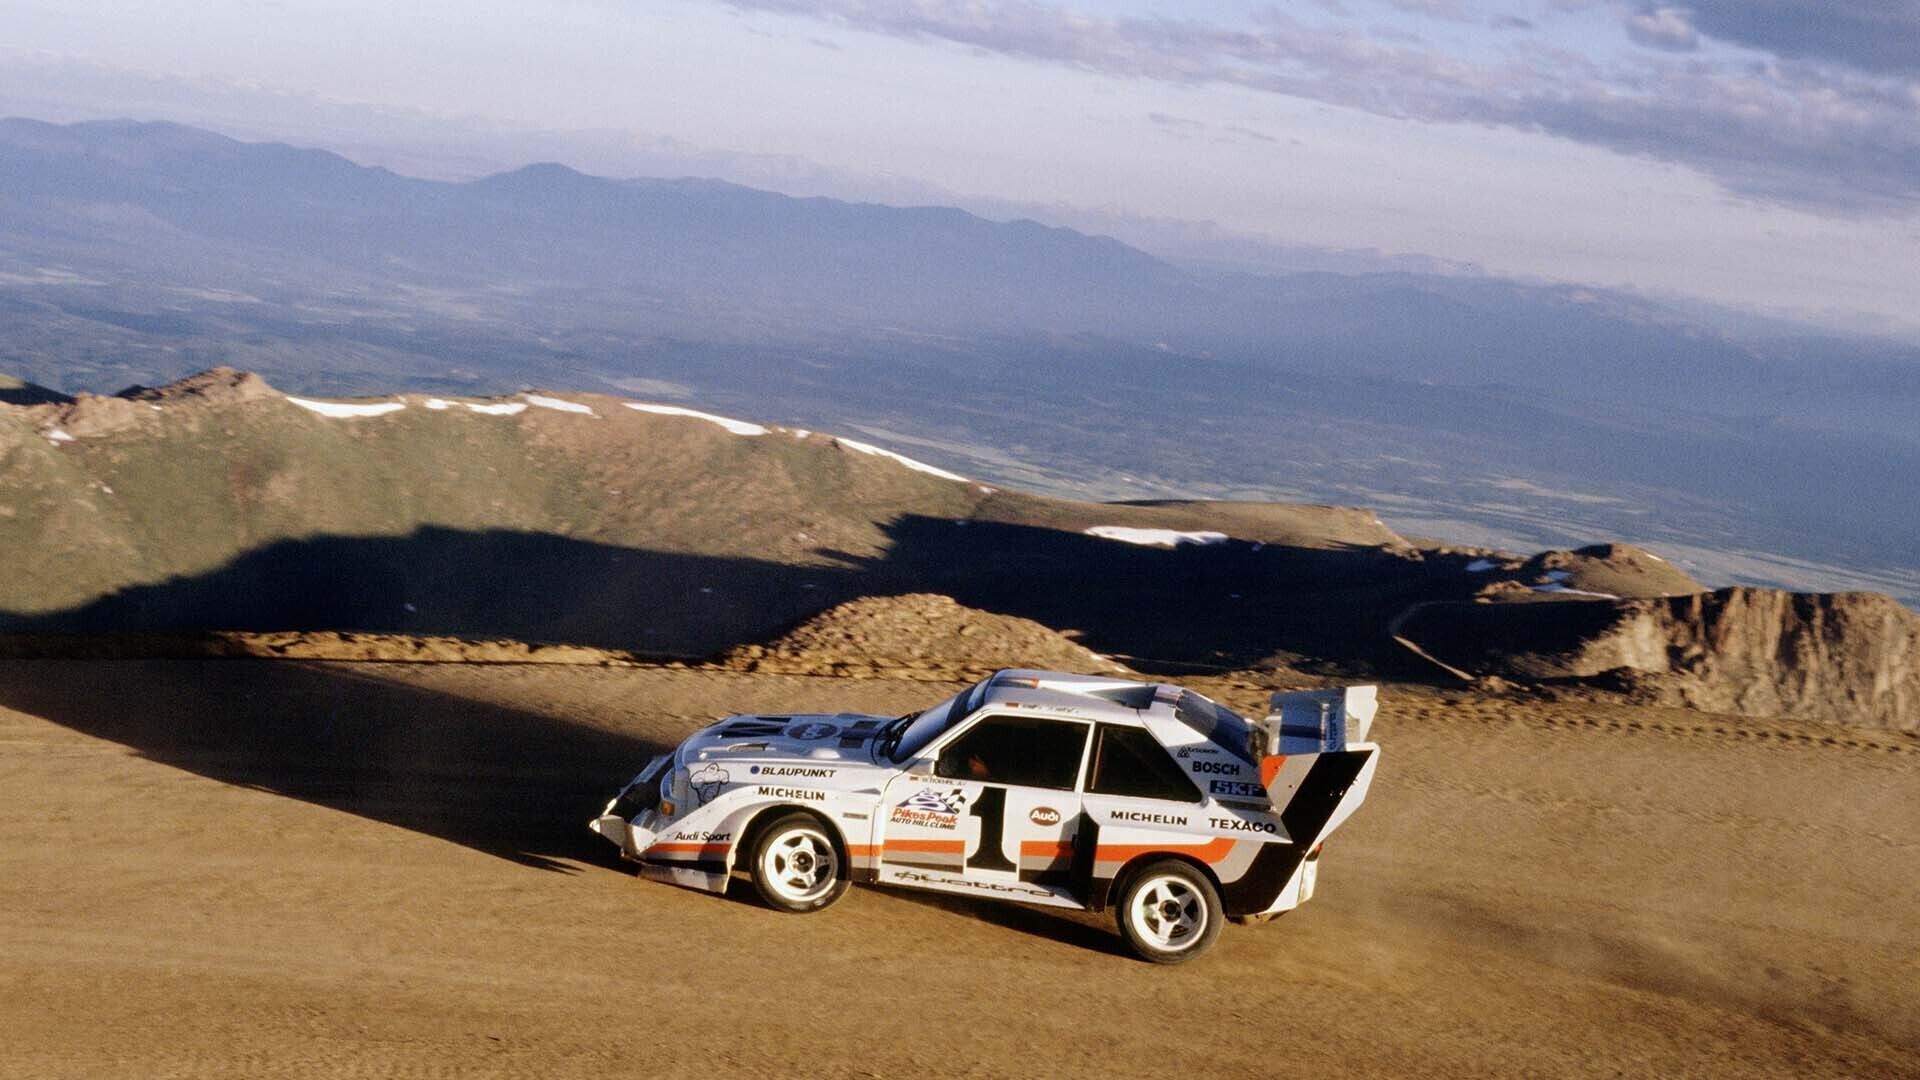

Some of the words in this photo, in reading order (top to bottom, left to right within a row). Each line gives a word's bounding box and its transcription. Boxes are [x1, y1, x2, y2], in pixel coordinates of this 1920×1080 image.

[761, 766, 836, 778] BLAUPUNKT
[1192, 761, 1240, 776] BOSCH
[757, 786, 825, 801] MICHELIN
[1215, 782, 1263, 796] SKF
[892, 808, 925, 819] Pikes
[926, 812, 959, 824] Peak
[1031, 811, 1059, 822] Audi
[1111, 810, 1188, 826] MICHELIN
[889, 817, 912, 825] AUTO
[929, 822, 956, 831] CLIMB
[966, 786, 1017, 872] 1
[1208, 817, 1277, 834] TEXACO
[674, 831, 699, 841] Audi
[701, 831, 731, 843] Sport
